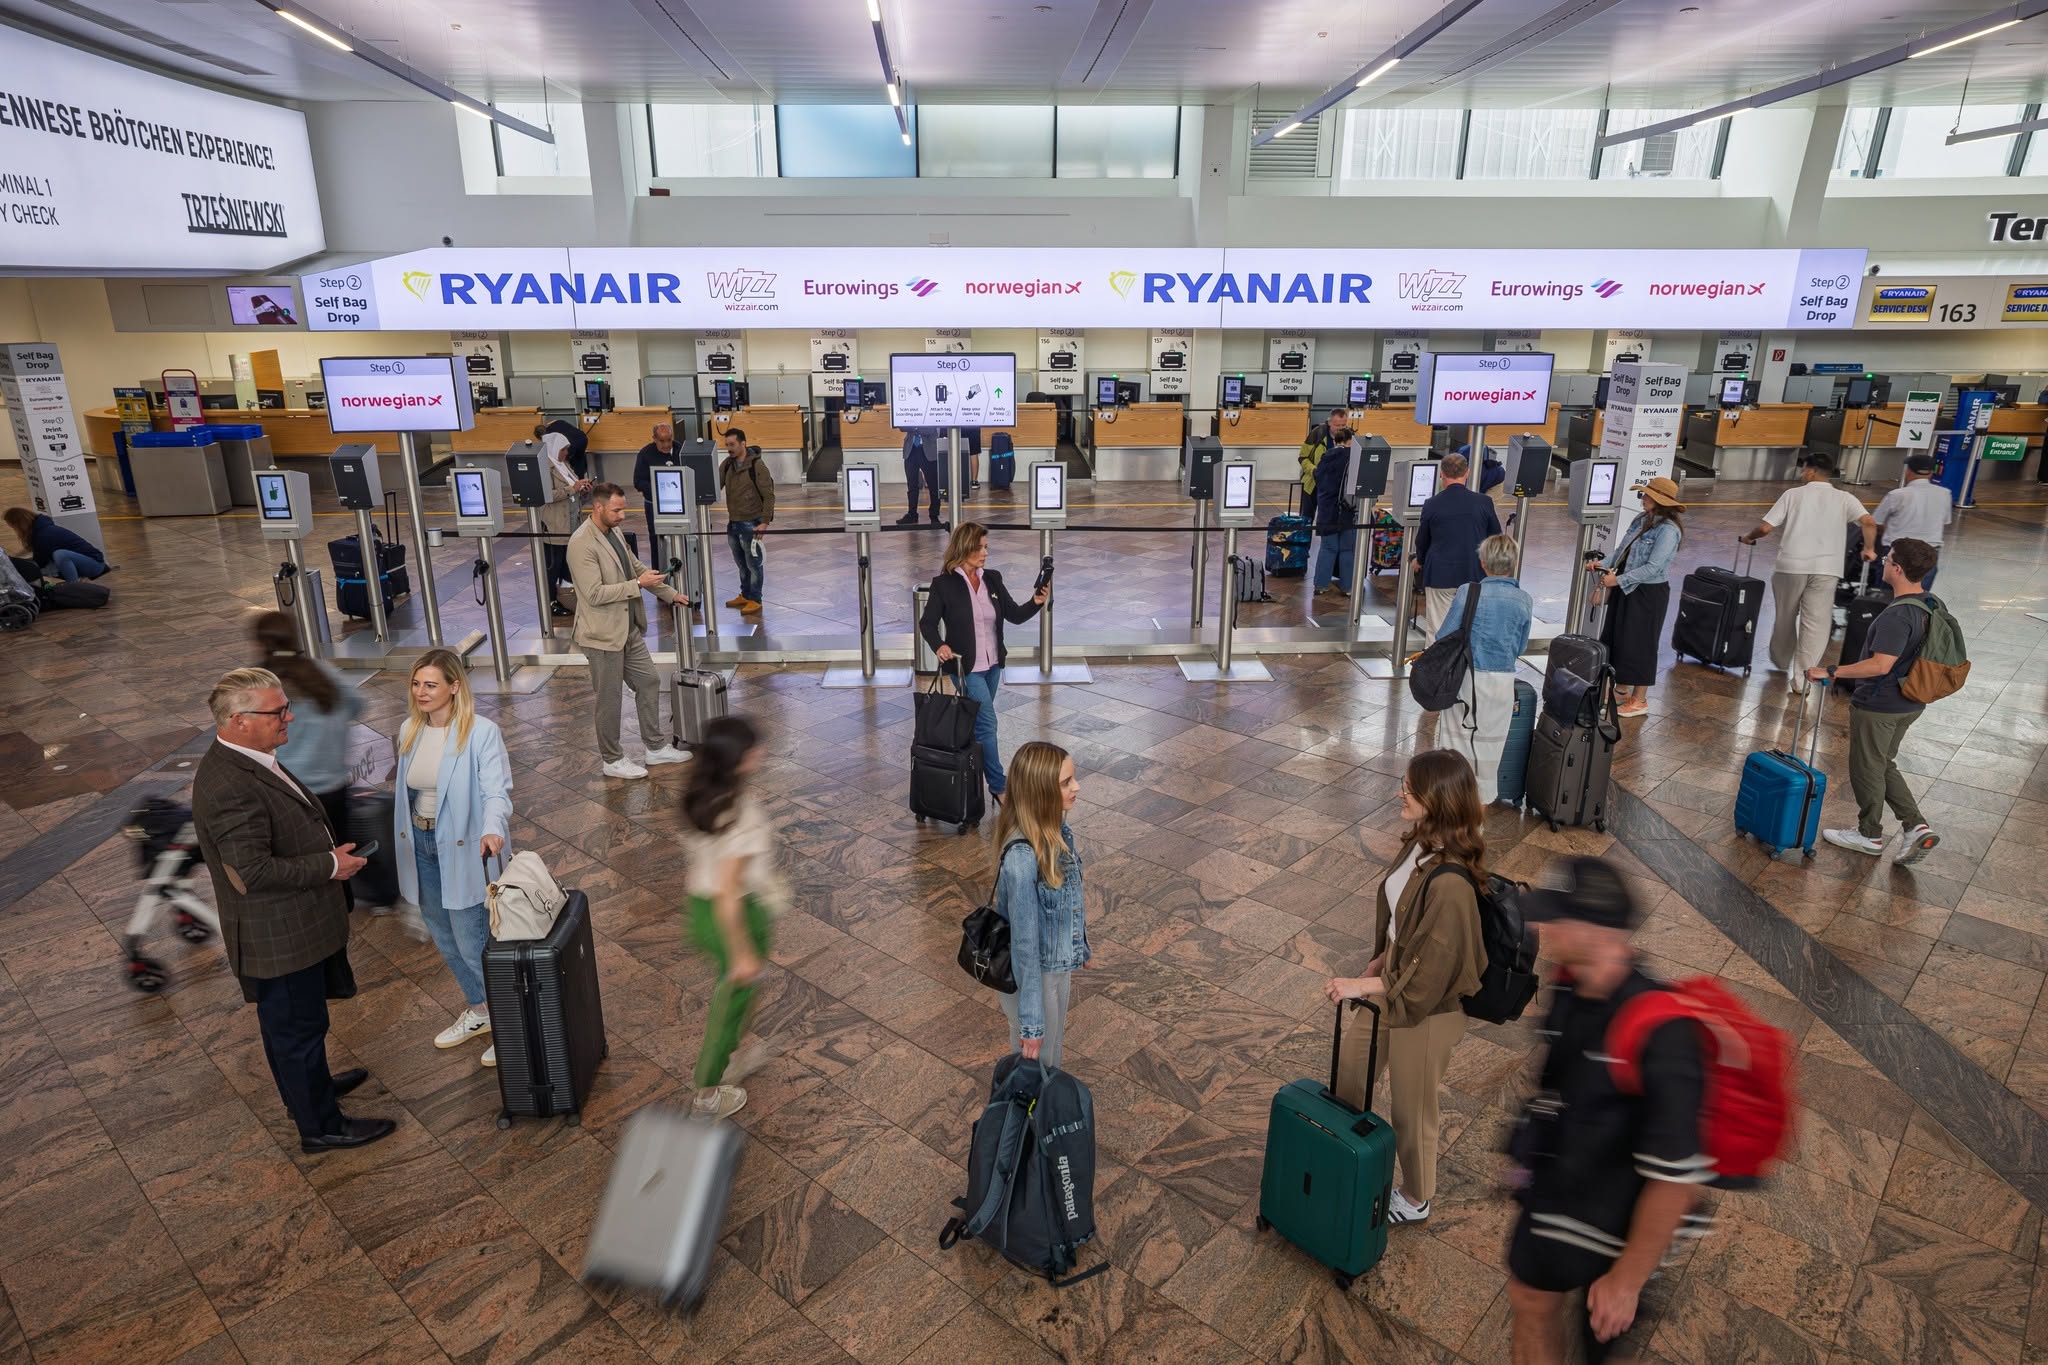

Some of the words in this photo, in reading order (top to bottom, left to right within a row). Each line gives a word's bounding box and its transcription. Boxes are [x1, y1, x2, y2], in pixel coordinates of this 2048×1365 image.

[0, 91, 87, 138] ENNESE
[87, 108, 185, 155] BRÖTCHEN
[185, 130, 275, 171] EXPERIENCE!
[45, 178, 52, 197] 1
[12, 203, 60, 226] CHECK
[181, 193, 286, 234] TRZEŚNIEWSKI
[319, 277, 345, 290] Step
[440, 272, 682, 305] RYANAIR
[804, 279, 899, 299] Eurowings
[965, 278, 1062, 297] norwegian
[1142, 272, 1373, 304] RYANAIR
[1810, 277, 1834, 289] Step
[1490, 280, 1583, 301] Eurowings
[1649, 280, 1745, 299] norwegian
[315, 296, 339, 309] Self
[342, 297, 367, 310] Bag
[724, 303, 779, 312] wizzair.com
[1411, 303, 1464, 312] wizzair.com
[1800, 296, 1824, 308] Self
[1825, 296, 1848, 309] Bag
[1873, 304, 1906, 313] SERVICE
[1907, 304, 1928, 313] DESK
[2006, 304, 2040, 313] SERVICE
[327, 312, 360, 325] Drop
[1806, 311, 1836, 323] Drop
[1939, 304, 1977, 323] 163
[17, 352, 34, 360] Self
[36, 352, 54, 360] Bag
[26, 362, 49, 370] Drop
[370, 363, 391, 374] Step
[937, 360, 957, 371] Step
[1479, 359, 1498, 370] Step
[1050, 376, 1060, 385] Self
[1061, 377, 1073, 385] Bag
[1159, 376, 1170, 384] Self
[1171, 377, 1183, 385] Bag
[1279, 377, 1290, 385] Self
[1391, 377, 1402, 385] Self
[1613, 373, 1624, 384] Self
[1625, 375, 1636, 386] Bag
[1645, 376, 1663, 387] Self
[1664, 377, 1681, 388] Bag
[1054, 383, 1069, 391] Drop
[1616, 386, 1630, 397] Drop
[1444, 388, 1520, 404] norwegian
[1650, 389, 1673, 399] Drop
[341, 393, 426, 409] norwegian
[1611, 404, 1633, 413] RYANAIR
[1991, 441, 2020, 450] Eingang
[1058, 1155, 1079, 1221] patagonia
